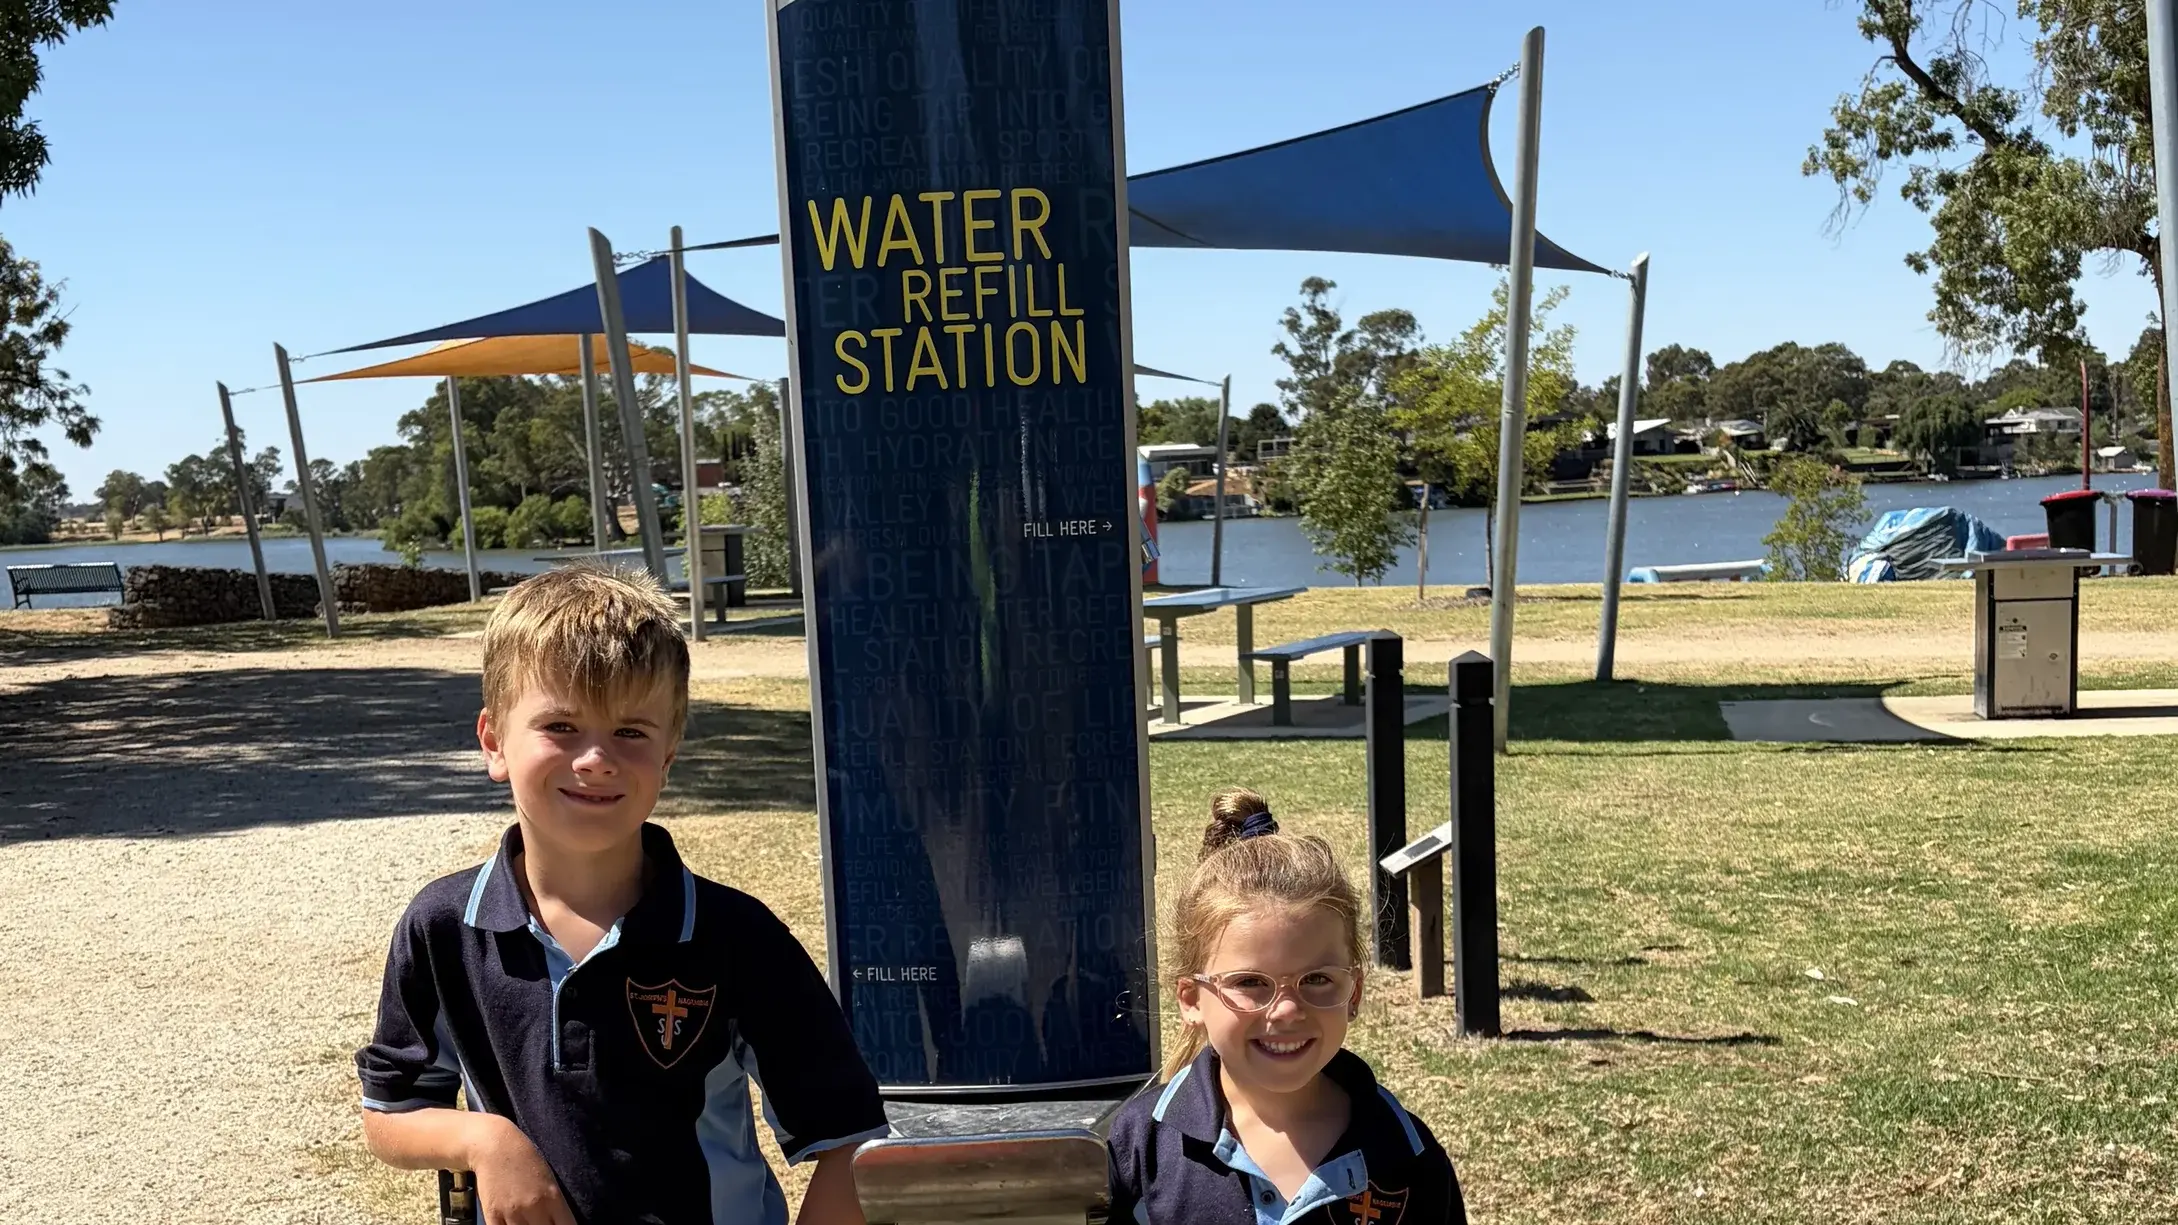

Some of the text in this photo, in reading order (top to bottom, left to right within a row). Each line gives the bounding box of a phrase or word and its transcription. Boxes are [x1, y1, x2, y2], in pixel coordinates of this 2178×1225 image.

[794, 55, 864, 99] ESH
[887, 46, 1048, 93] QUALITY
[792, 96, 895, 139] BEING
[996, 86, 1067, 129] INTO
[807, 187, 1052, 272] WATER
[901, 262, 1085, 323] REFILL
[834, 318, 1087, 395] STATION
[880, 393, 972, 431] GOOD
[992, 386, 1117, 428] HEALTH
[862, 426, 1058, 471] HYDRATION
[827, 492, 932, 526] VALLEY
[1023, 519, 1098, 538] FILL HERE
[1034, 540, 1124, 596] TAP
[830, 601, 939, 636] HEALTH
[950, 595, 1054, 633] WTER
[864, 631, 1001, 673] STATION
[1012, 690, 1065, 733] OF
[930, 735, 1029, 766] STATION
[867, 966, 938, 982] FILL HERE
